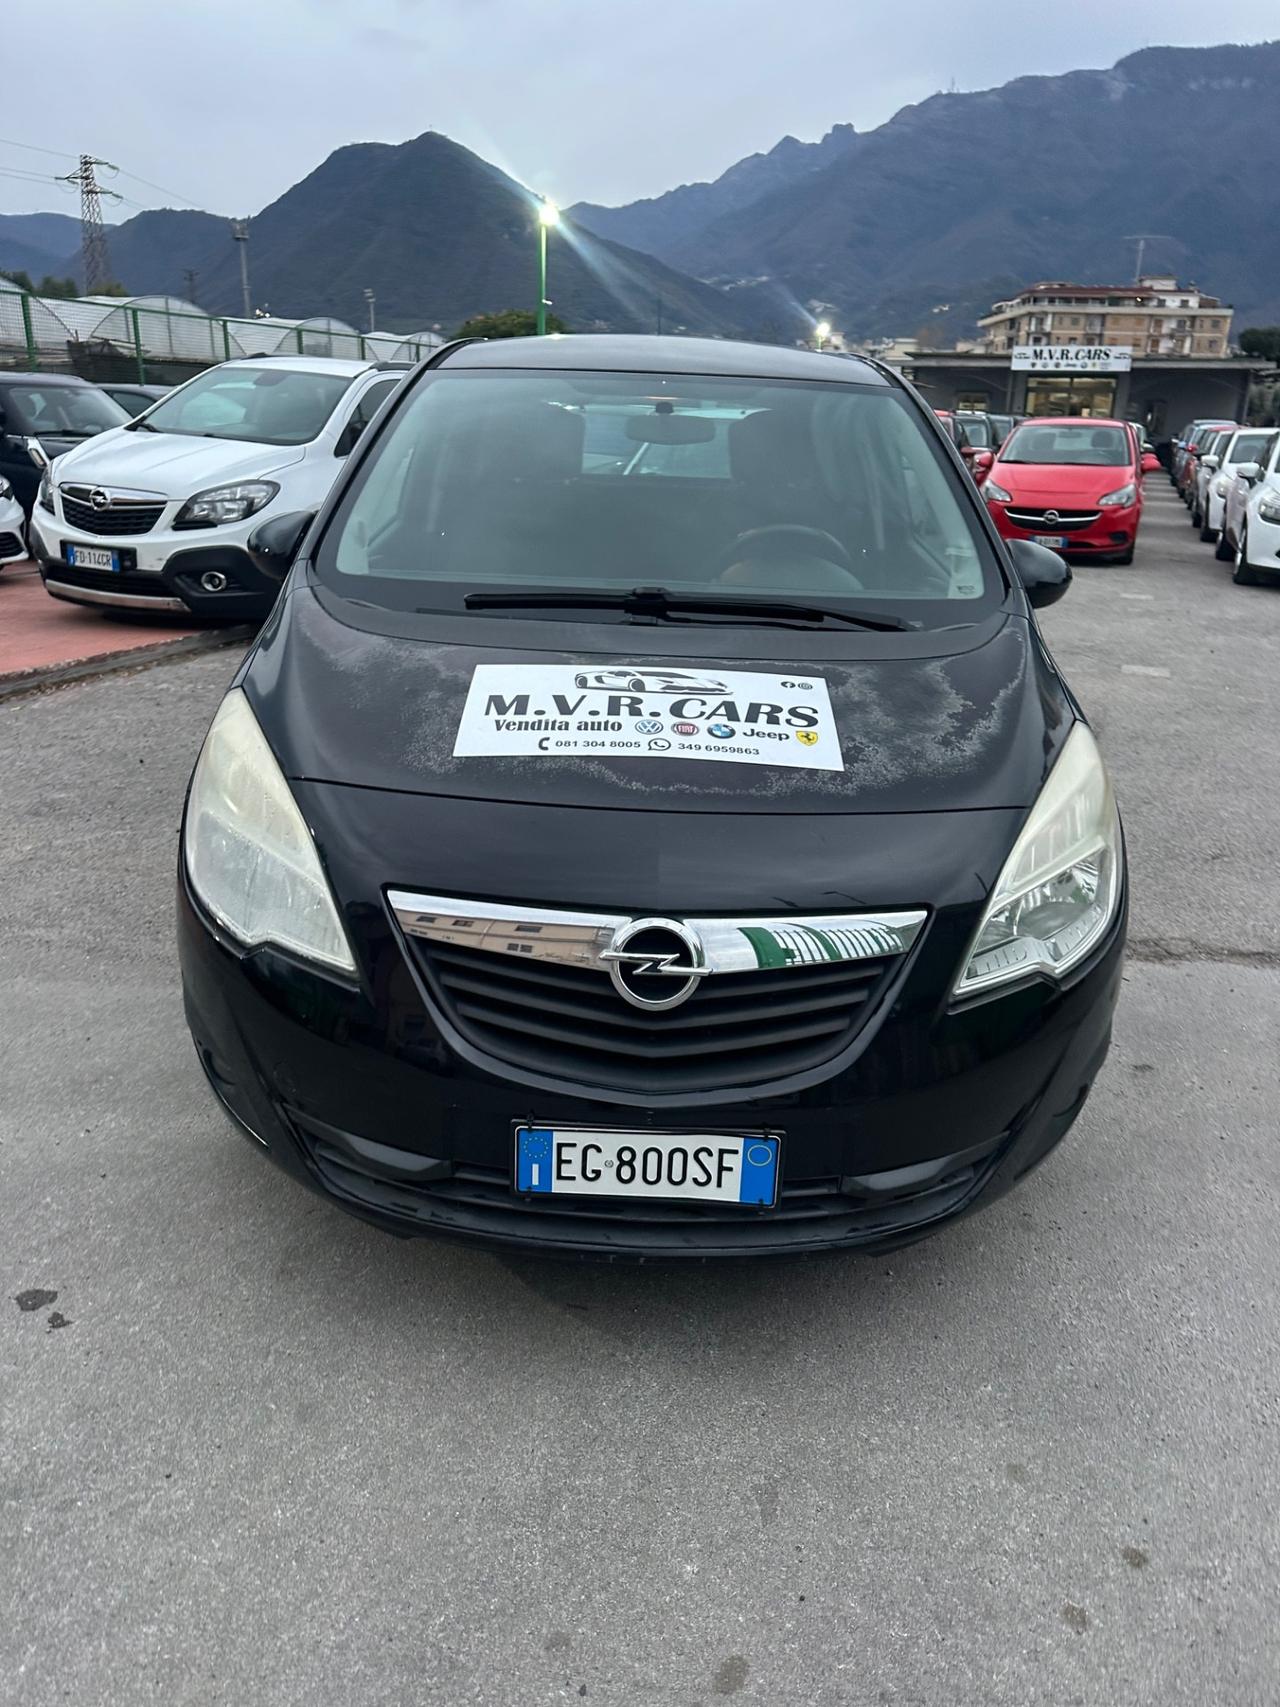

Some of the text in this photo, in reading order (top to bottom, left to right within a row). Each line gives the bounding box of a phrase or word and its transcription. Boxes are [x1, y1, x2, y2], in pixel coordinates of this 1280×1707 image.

[494, 719, 623, 732] Vendita auto
[743, 728, 790, 741] Jeep
[583, 740, 606, 748] 304
[678, 742, 760, 756] 349 6959863
